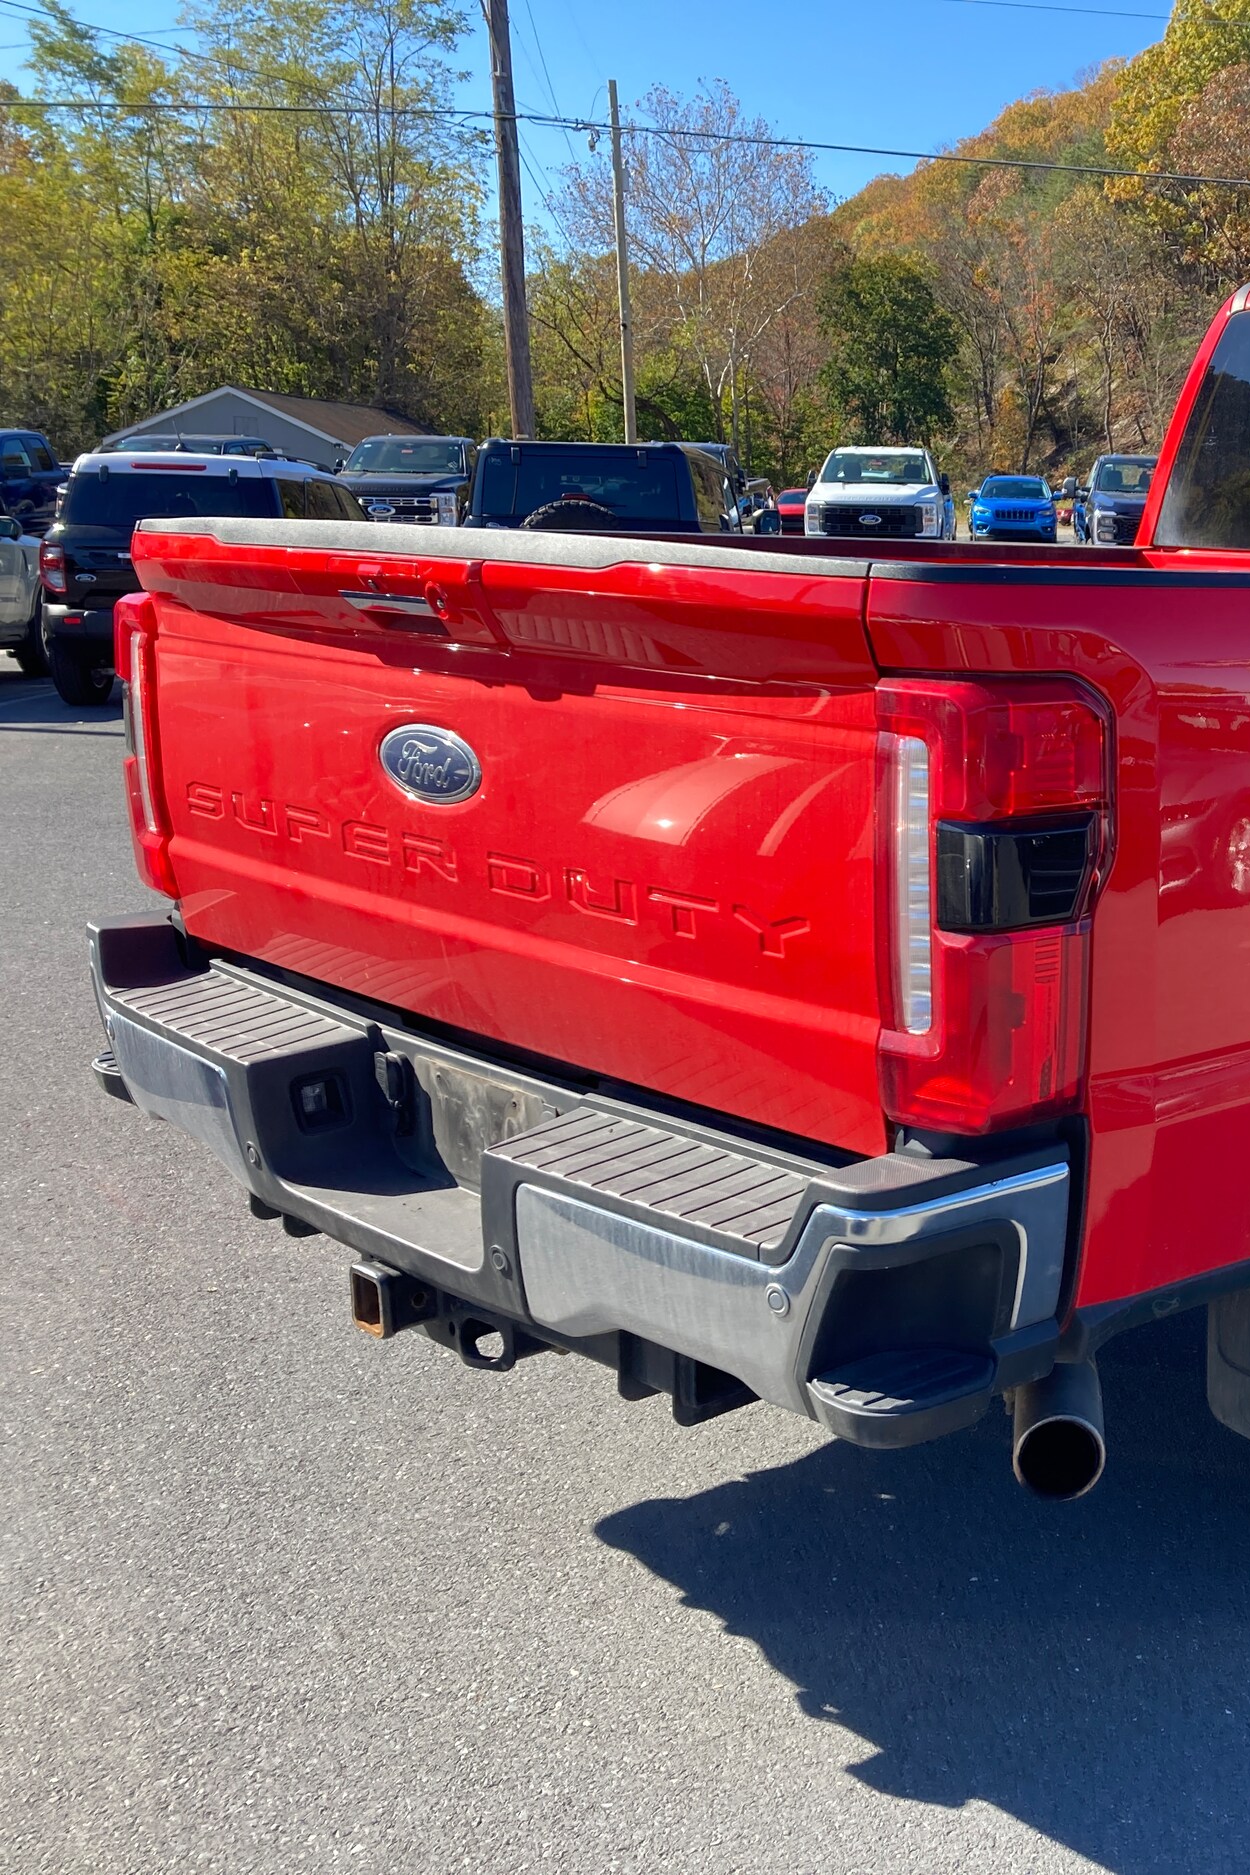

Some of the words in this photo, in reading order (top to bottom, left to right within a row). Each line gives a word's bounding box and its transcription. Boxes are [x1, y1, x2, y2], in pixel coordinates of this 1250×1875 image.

[397, 739, 452, 789] Ford
[186, 780, 460, 882] SUPER
[487, 850, 811, 958] DUTY
